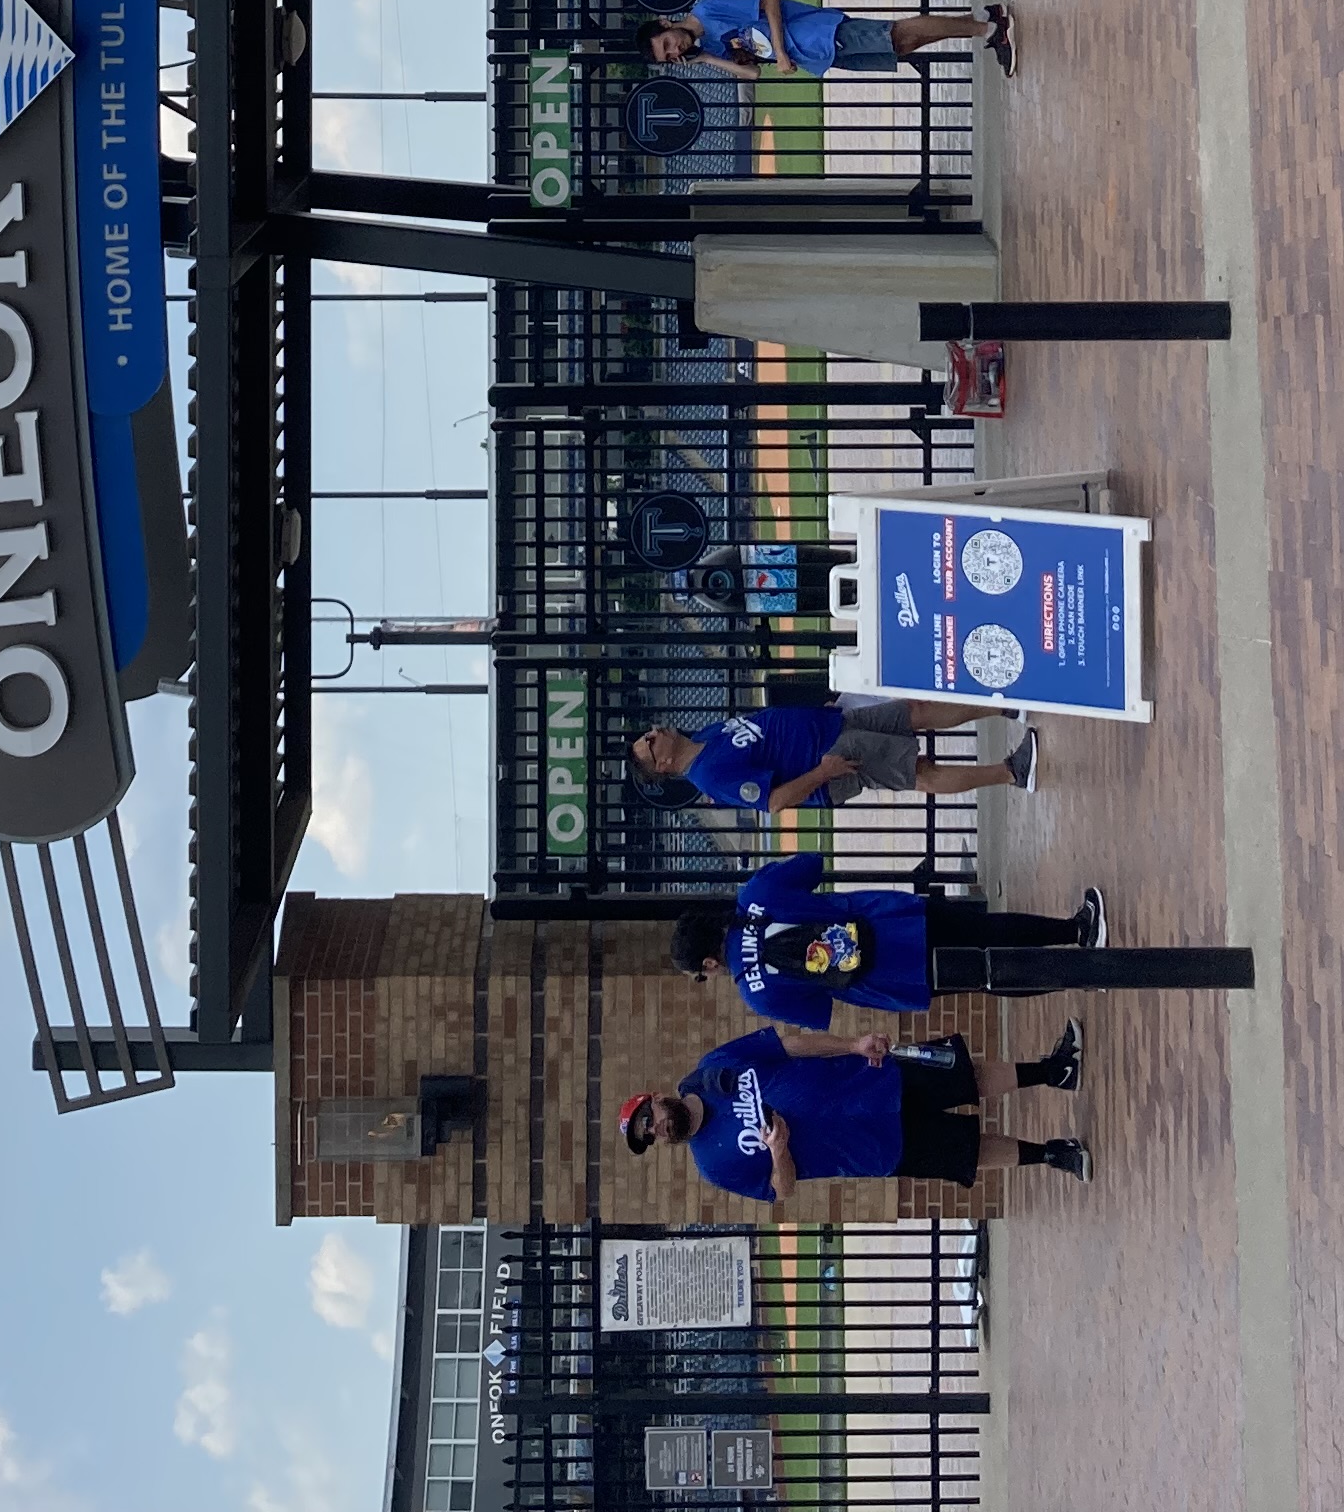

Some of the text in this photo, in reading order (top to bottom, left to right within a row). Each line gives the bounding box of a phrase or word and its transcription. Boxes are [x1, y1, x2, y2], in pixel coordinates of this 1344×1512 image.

[100, 82, 127, 149] THE
[532, 57, 569, 206] OPEN
[102, 162, 129, 209] OF
[103, 222, 133, 331] HOME
[933, 533, 941, 584] LOGIN TO
[945, 518, 953, 568] ACCOUNT
[894, 572, 919, 627] Drillers
[1044, 574, 1054, 650] DIRECTIONS
[934, 641, 942, 661] THE
[946, 616, 954, 657] ONLINE!
[935, 664, 943, 688] SKIP
[946, 658, 954, 680] BUY
[547, 691, 584, 842] OPEN
[733, 1068, 767, 1155] Drillers
[489, 1263, 510, 1334] FIELD
[609, 1254, 628, 1321] Drillers
